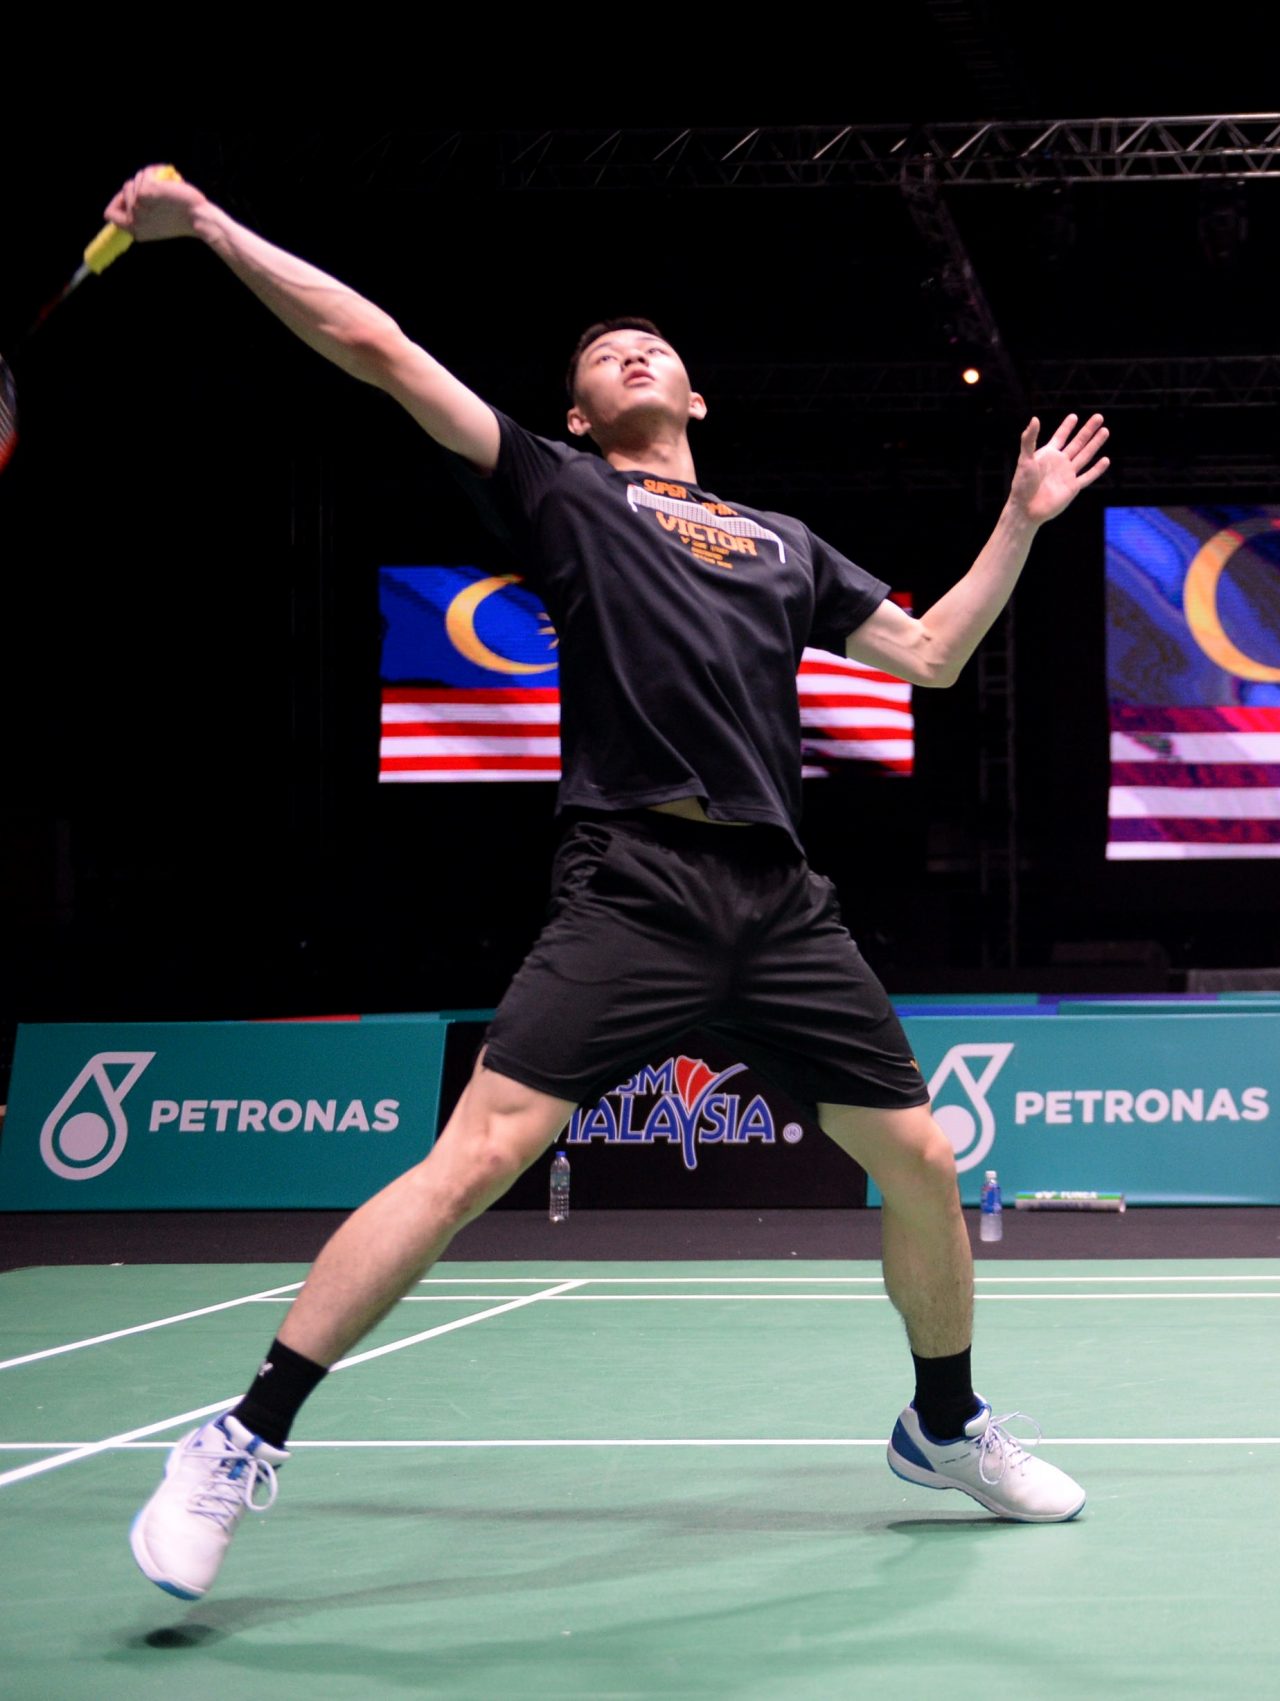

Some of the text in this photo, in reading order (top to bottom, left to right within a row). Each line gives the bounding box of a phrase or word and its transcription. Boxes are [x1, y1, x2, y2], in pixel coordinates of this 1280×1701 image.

[656, 511, 757, 556] VICTOR
[148, 1098, 400, 1133] PETRONAS
[1014, 1086, 1270, 1125] PETRONAS
